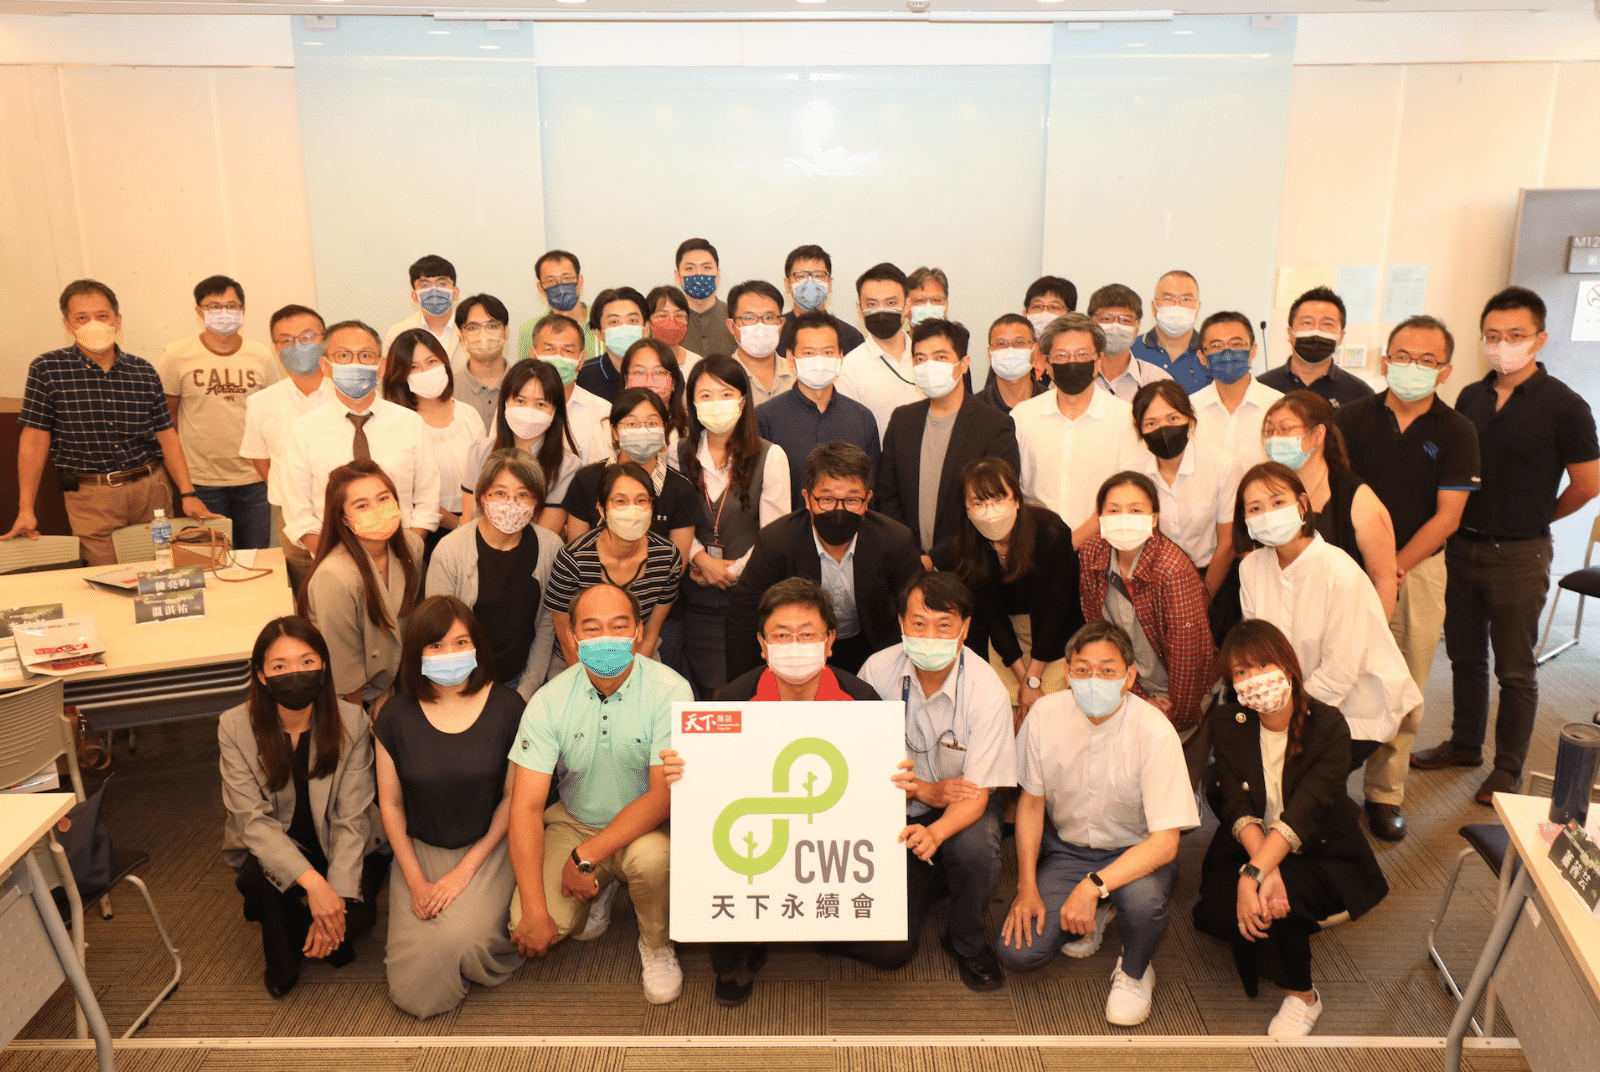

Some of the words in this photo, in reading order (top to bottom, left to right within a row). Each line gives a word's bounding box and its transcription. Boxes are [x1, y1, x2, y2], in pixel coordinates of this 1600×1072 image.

[193, 368, 257, 388] CALIS
[684, 712, 717, 732] 天下
[794, 839, 875, 884] CWS
[711, 892, 875, 920] 天下永續會
